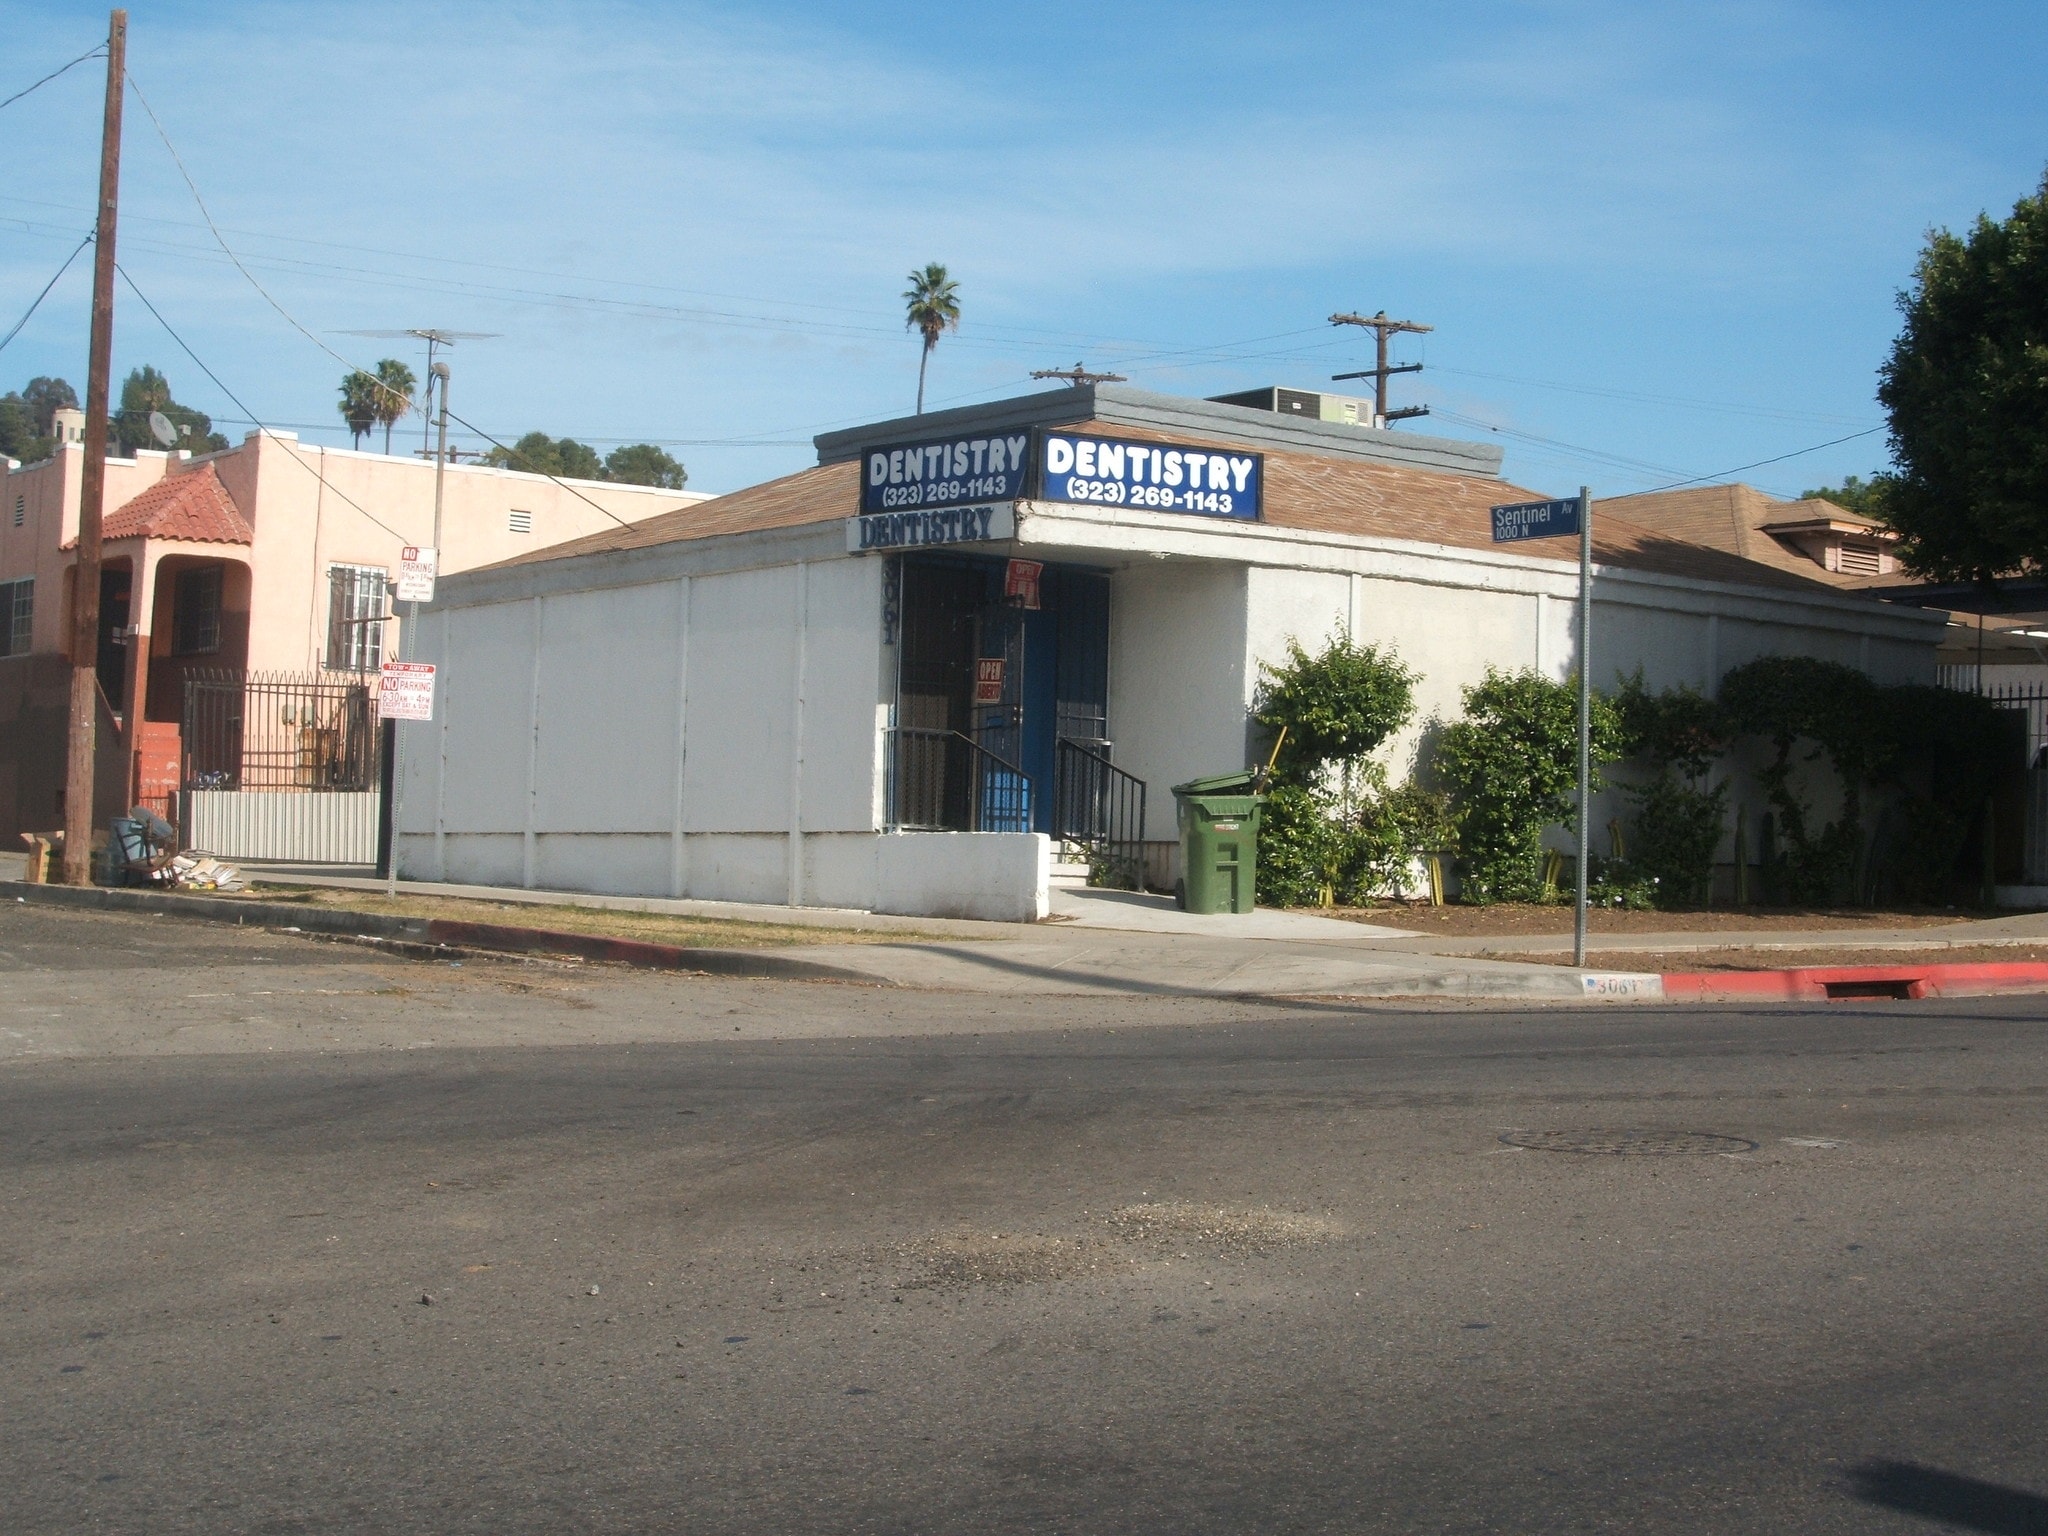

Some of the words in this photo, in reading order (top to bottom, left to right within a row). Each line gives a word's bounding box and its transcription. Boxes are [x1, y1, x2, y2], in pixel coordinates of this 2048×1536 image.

[870, 435, 1026, 487] DENTISTRY
[1047, 438, 1253, 492] DENTISTRY
[883, 483, 923, 507] (323)
[926, 475, 1007, 502] 269-1143
[1066, 476, 1126, 504] (323)
[1130, 485, 1233, 513] 269-1143
[1496, 503, 1551, 527] Sentinel
[1561, 501, 1573, 514] Av
[858, 507, 994, 548] DENTISTRY
[1496, 525, 1518, 540] 1000
[1522, 524, 1529, 537] N
[403, 549, 416, 560] NO
[402, 561, 433, 574] PARKING
[388, 664, 429, 672] TOW-AWAY
[980, 661, 1002, 681] OPEN
[383, 678, 398, 691] NO
[400, 681, 431, 692] PARKING
